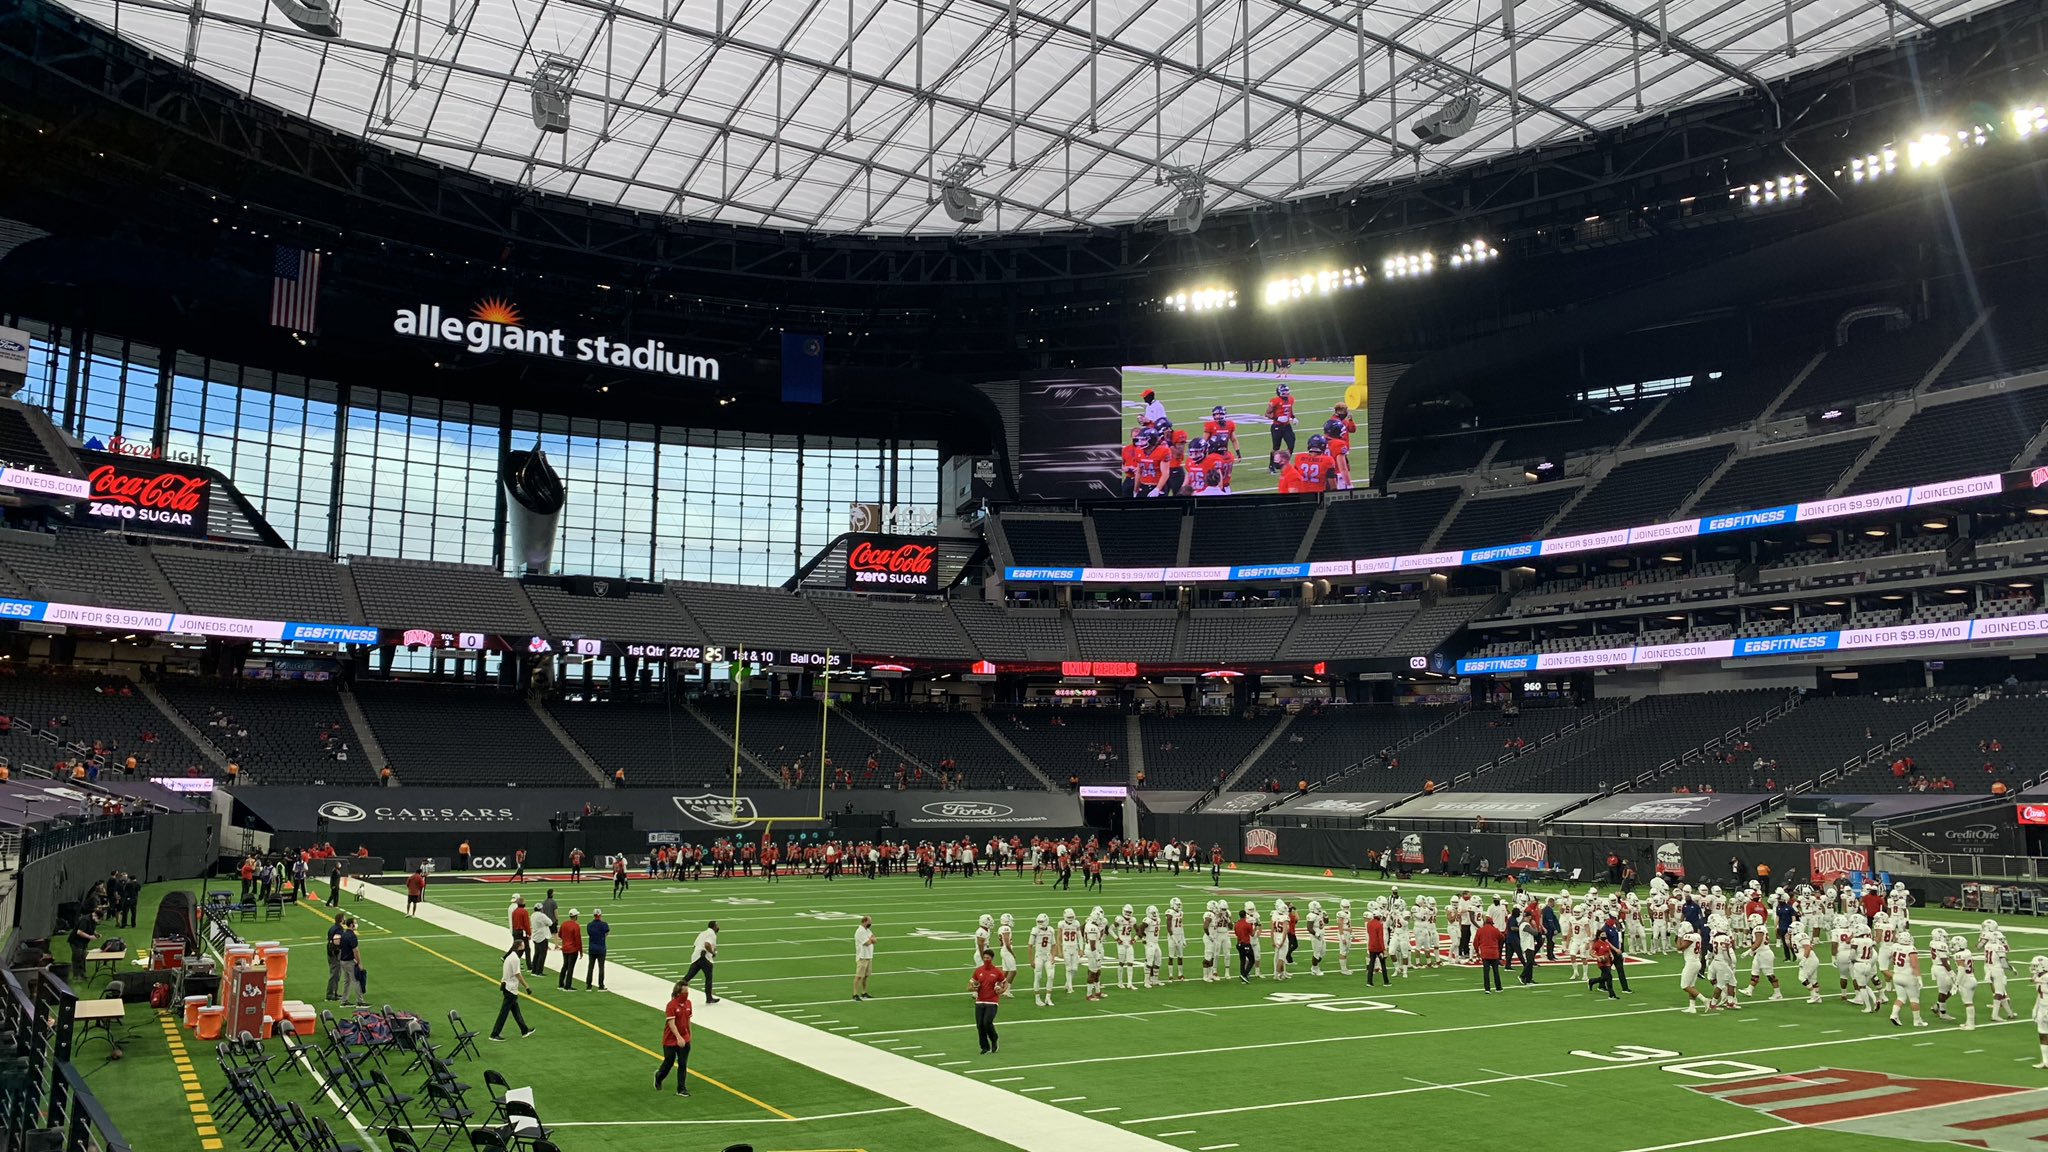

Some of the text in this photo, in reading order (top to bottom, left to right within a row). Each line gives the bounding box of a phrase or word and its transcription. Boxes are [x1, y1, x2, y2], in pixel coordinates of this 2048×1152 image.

[394, 304, 719, 380] allegiant stadium
[108, 436, 161, 458] Coors
[89, 465, 208, 511] Coca-Cola
[1917, 480, 1994, 500] JOINEOS.COM
[1802, 494, 1902, 517] JOIN FOR $9.99/MO
[88, 502, 192, 526] zero SUGAR
[882, 504, 937, 524] MGM
[1545, 534, 1624, 552] JOIN FOR $9.99/MO
[850, 542, 937, 573] Coca-Cola
[1086, 571, 1102, 580] JOIN
[1104, 571, 1120, 580] FOR
[1313, 564, 1332, 573] JOIN
[1333, 564, 1349, 572] FOR
[856, 572, 927, 584] zero SUGAR
[52, 609, 162, 628] JOIN FOR $9.99/MO
[180, 620, 254, 634] JOINEOS.COM
[468, 635, 476, 646] 0
[1846, 626, 1961, 644] JOIN FOR $9.99/MO
[585, 642, 594, 652] 0
[626, 645, 665, 657] 1st Qtr
[670, 646, 700, 658] 27:02
[704, 646, 723, 662] 25
[1641, 646, 1706, 660] JOINEOS.COM
[732, 650, 774, 662] 1st & 10
[790, 653, 840, 665] Ball On 25
[1412, 658, 1425, 668] CC
[1542, 652, 1628, 666] JOIN FOR $9.99/MO
[1092, 662, 1138, 677] REBELS
[1524, 682, 1542, 691] 960
[374, 807, 514, 818] CAESARS
[942, 804, 996, 816] Ford
[1246, 828, 1277, 853] UNLV
[1508, 838, 1547, 864] UNLV
[472, 856, 507, 869] COX
[1814, 848, 1866, 876] UNLV
